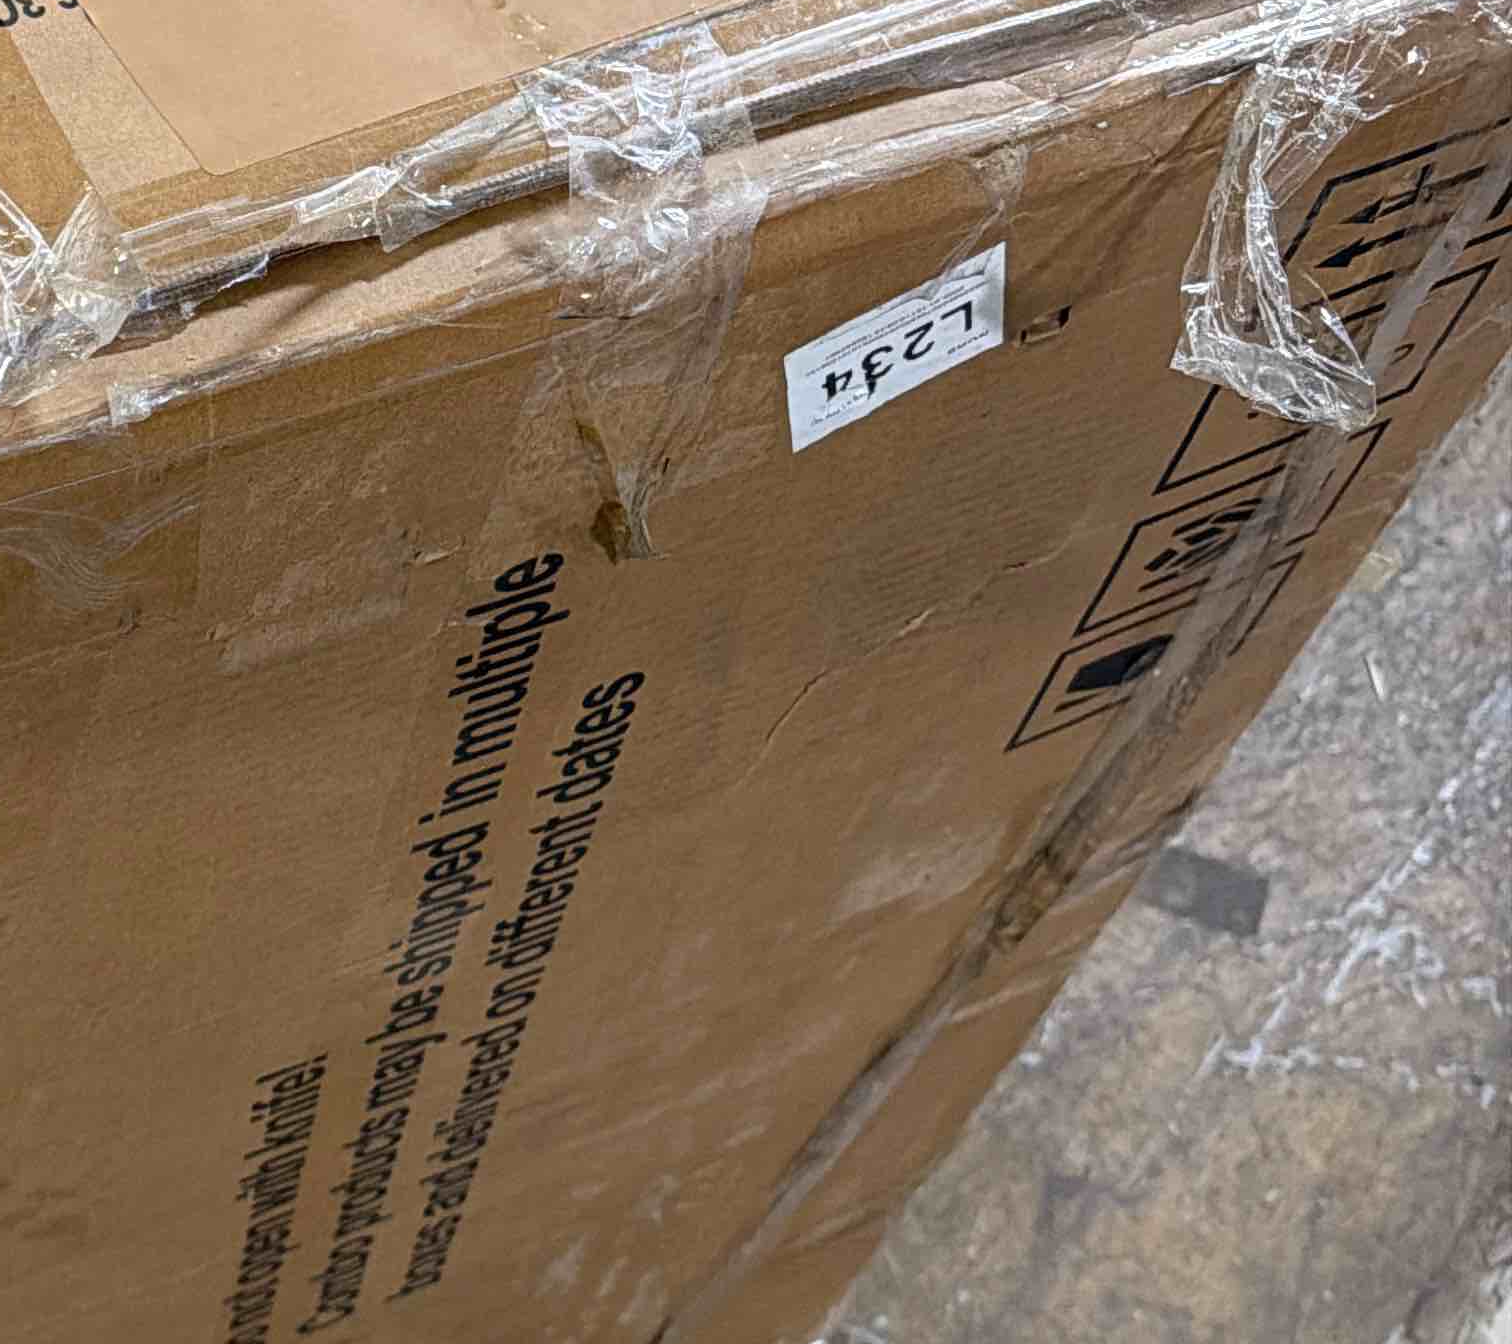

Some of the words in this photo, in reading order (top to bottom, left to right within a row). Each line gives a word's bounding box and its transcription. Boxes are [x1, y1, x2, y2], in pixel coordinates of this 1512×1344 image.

[446, 552, 571, 769] multiple
[536, 670, 647, 804] dates
[417, 761, 507, 825] in
[383, 820, 493, 987] shipped
[484, 798, 605, 971] different
[364, 983, 445, 1044] be
[485, 963, 547, 1020] on
[244, 1051, 329, 1160] knife!
[366, 1030, 448, 1112] may
[426, 1015, 529, 1164] delivered
[236, 1144, 310, 1219] with
[328, 1106, 410, 1241] products
[419, 1156, 481, 1219] and
[237, 1208, 302, 1285] open
